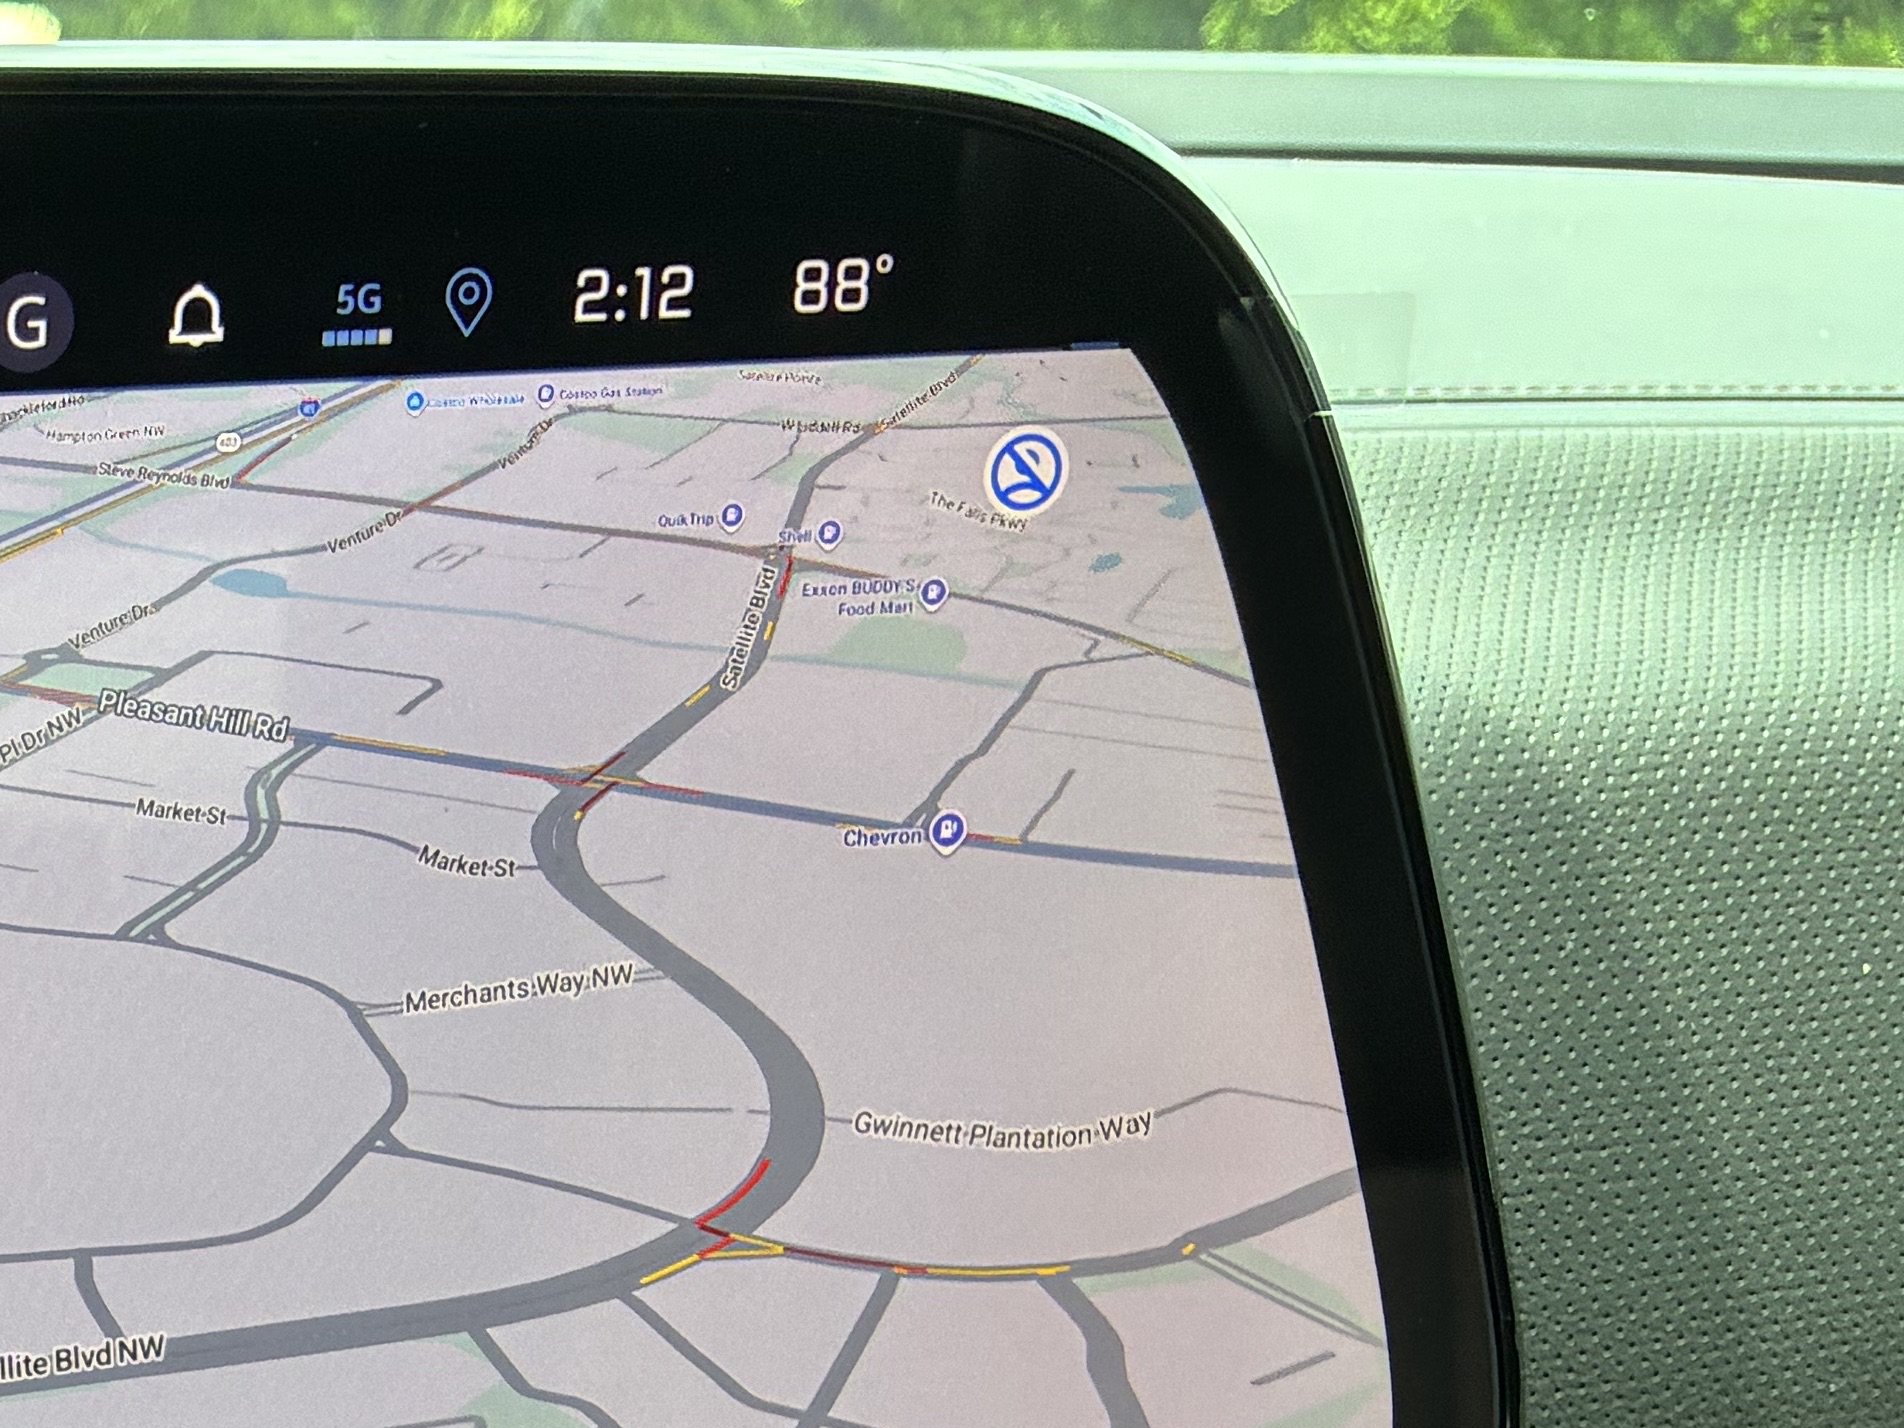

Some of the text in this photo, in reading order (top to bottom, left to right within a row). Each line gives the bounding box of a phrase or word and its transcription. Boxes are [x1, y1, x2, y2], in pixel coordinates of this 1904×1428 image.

[337, 283, 382, 314] 5G
[574, 265, 693, 323] 2:12
[793, 253, 894, 313] 88°
[7, 295, 46, 349] G
[538, 418, 555, 435] Dr
[879, 391, 932, 432] Satellite
[46, 425, 165, 443] Hampton Green NW
[98, 461, 230, 489] Steve Reynolds Blvd
[327, 511, 403, 554] Venture Dr
[68, 603, 152, 650] Venture Dr
[721, 564, 775, 691] Satellite Blvd
[838, 601, 913, 617] Food Mart
[22, 725, 49, 751] Dr
[48, 708, 84, 738] NW
[97, 688, 290, 742] Pleasant Hill Rd
[136, 800, 226, 825] Market St
[843, 827, 923, 849] Chevron
[418, 845, 515, 877] Market St
[404, 962, 634, 1014] Merchants Way NW
[854, 1110, 1153, 1151] Gwinnett Plantation Way
[54, 1343, 113, 1374] Blvd
[117, 1335, 165, 1364] NW
